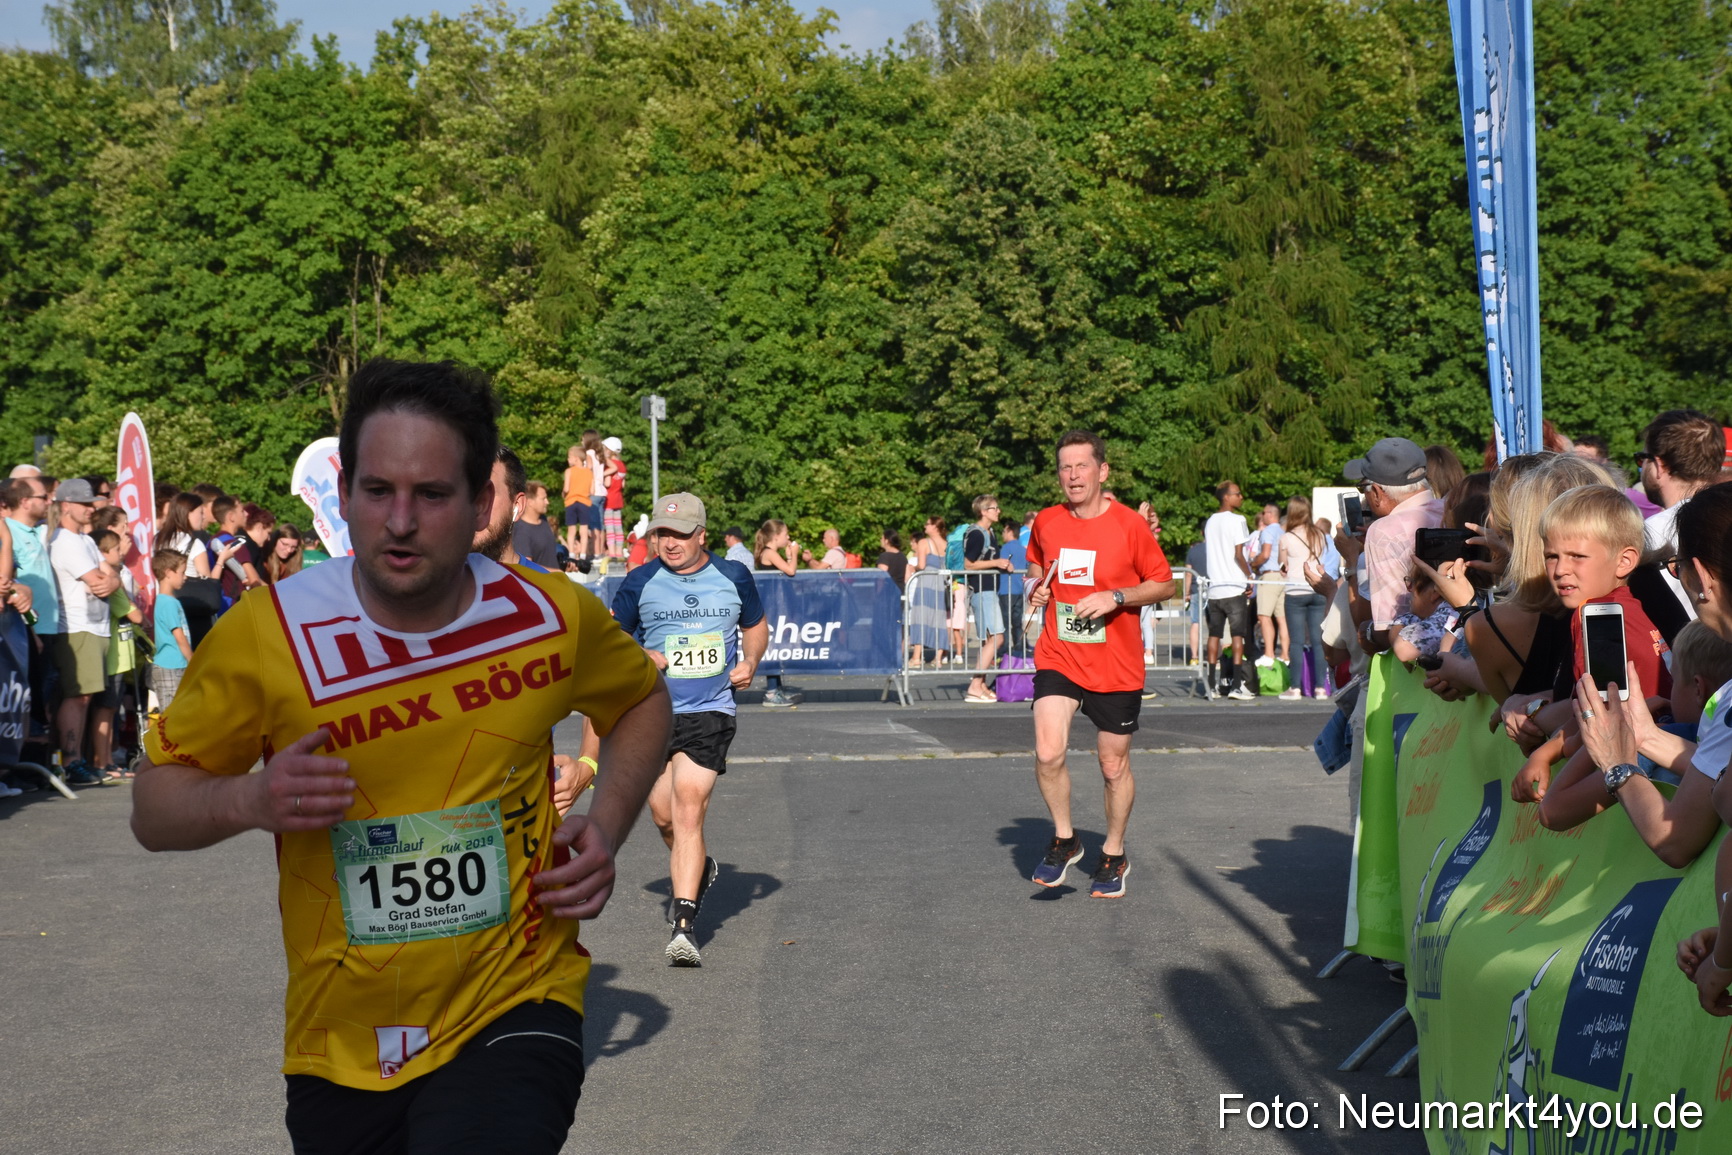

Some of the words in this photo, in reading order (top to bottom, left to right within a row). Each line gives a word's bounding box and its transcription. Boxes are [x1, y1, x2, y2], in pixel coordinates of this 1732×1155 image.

[653, 608, 731, 621] SCHABMÜLLER
[1065, 617, 1092, 634] 554
[673, 648, 718, 667] 2118
[318, 692, 443, 754] MAX
[452, 652, 572, 713] BÖGL
[358, 838, 425, 857] firmenlauf
[465, 835, 494, 850] 2019
[359, 851, 486, 909] 1580
[369, 925, 386, 933] Max
[387, 921, 409, 933] Bögl
[410, 916, 460, 930] Bauservice
[461, 909, 488, 921] GmbH
[388, 909, 420, 922] Grad
[424, 903, 466, 919] Stefan
[1589, 934, 1639, 973] Fischer
[1586, 975, 1625, 995] AUTOMOBILE
